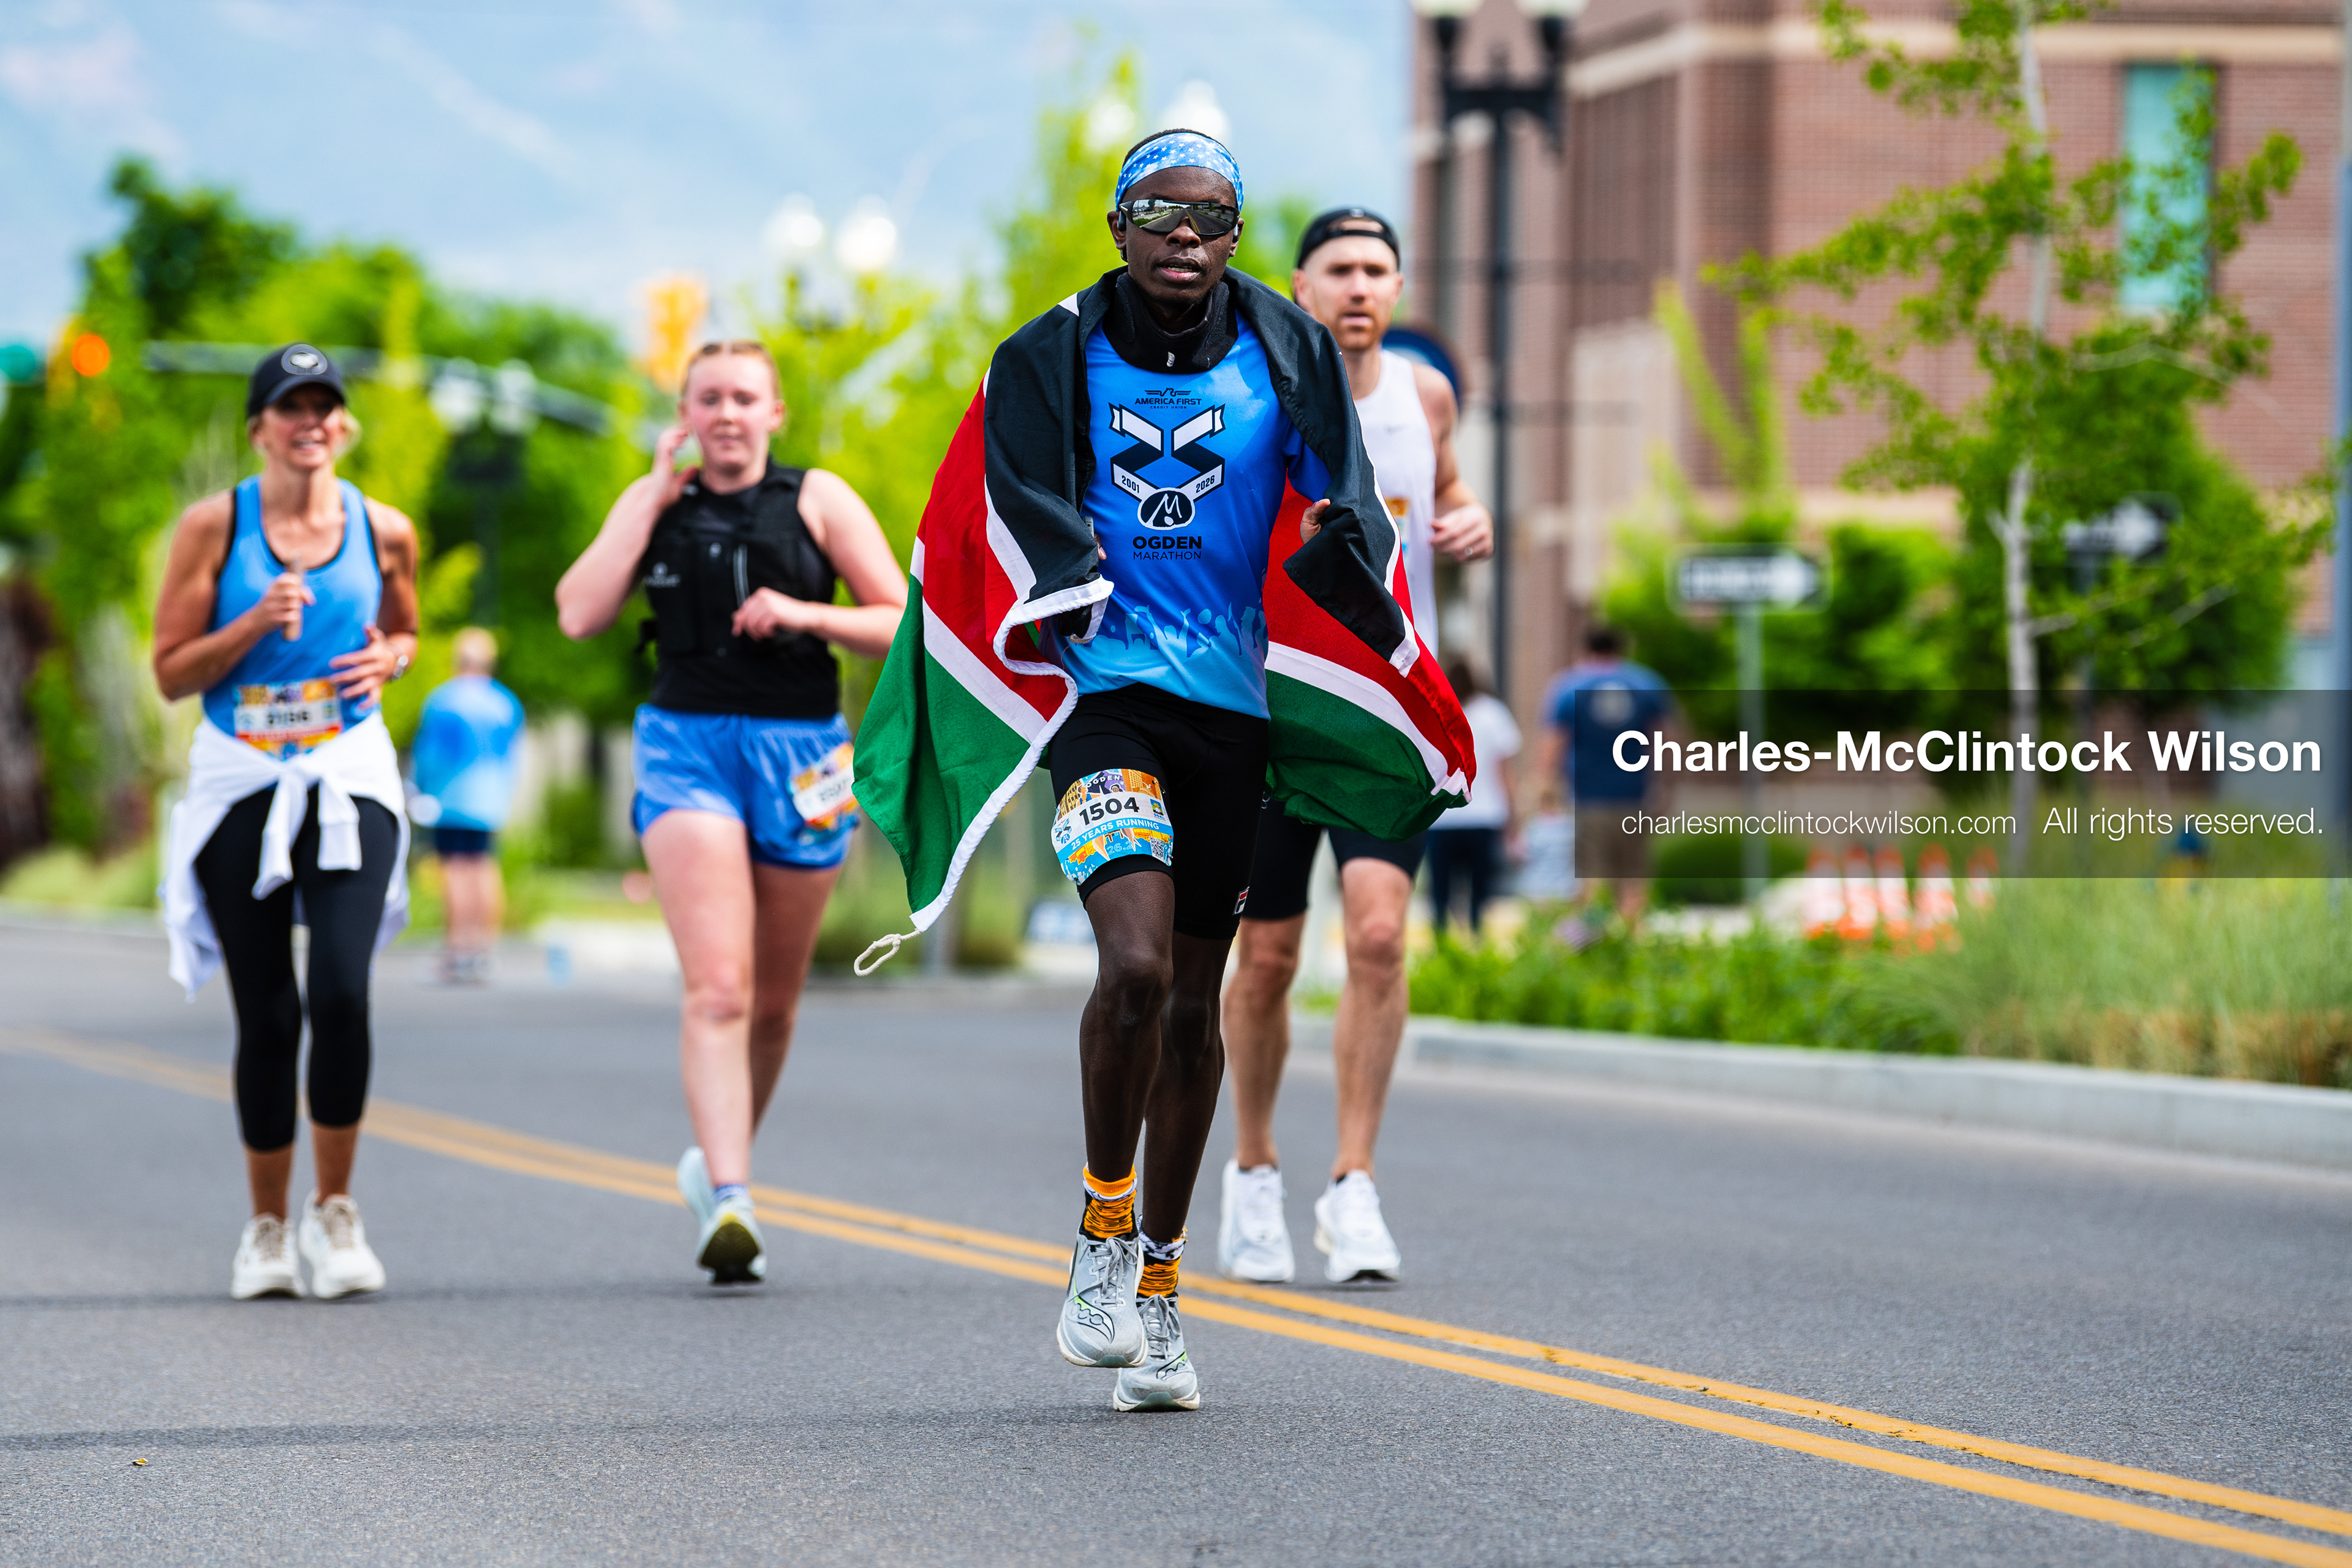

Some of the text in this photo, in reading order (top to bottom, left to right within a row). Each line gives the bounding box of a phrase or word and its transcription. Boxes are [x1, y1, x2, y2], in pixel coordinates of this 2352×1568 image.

[1121, 475, 1139, 494] 2001
[1196, 475, 1215, 494] 2026
[1133, 536, 1202, 549] OGDEN
[1133, 551, 1202, 560] MARATHON
[1087, 775, 1120, 788] OGDEN
[1079, 797, 1140, 826] 1504
[1071, 818, 1159, 850] 25 YEARS RUNNING
